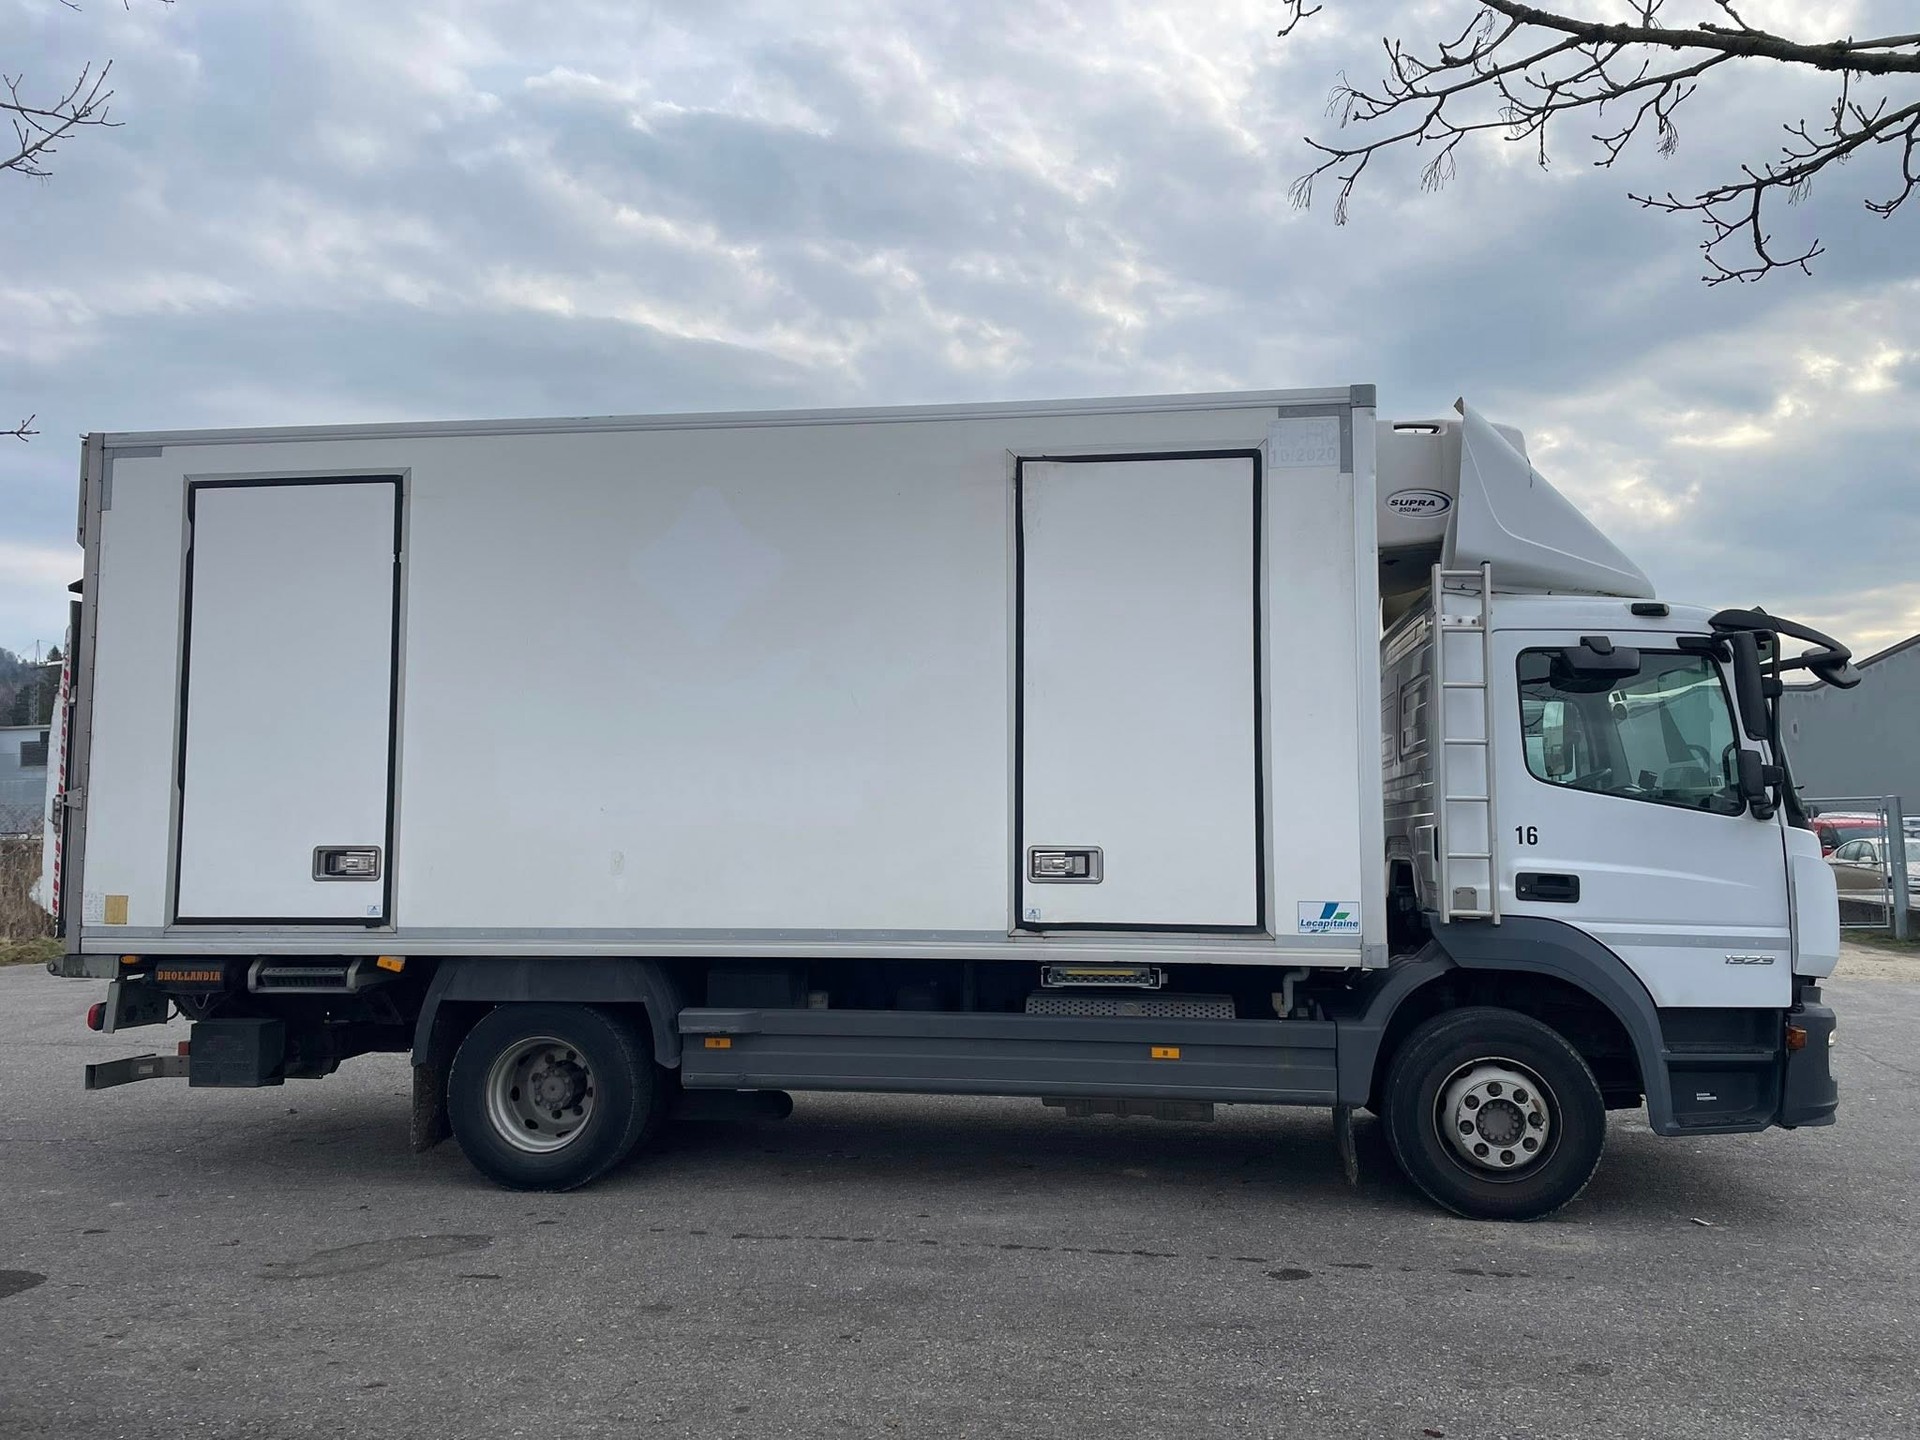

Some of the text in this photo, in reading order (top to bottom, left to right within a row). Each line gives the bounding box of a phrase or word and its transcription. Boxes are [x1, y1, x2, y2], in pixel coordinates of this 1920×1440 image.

[1515, 825, 1538, 846] 16
[1300, 919, 1359, 929] Lecapitaine
[157, 970, 221, 981] DHOLLANDIA
